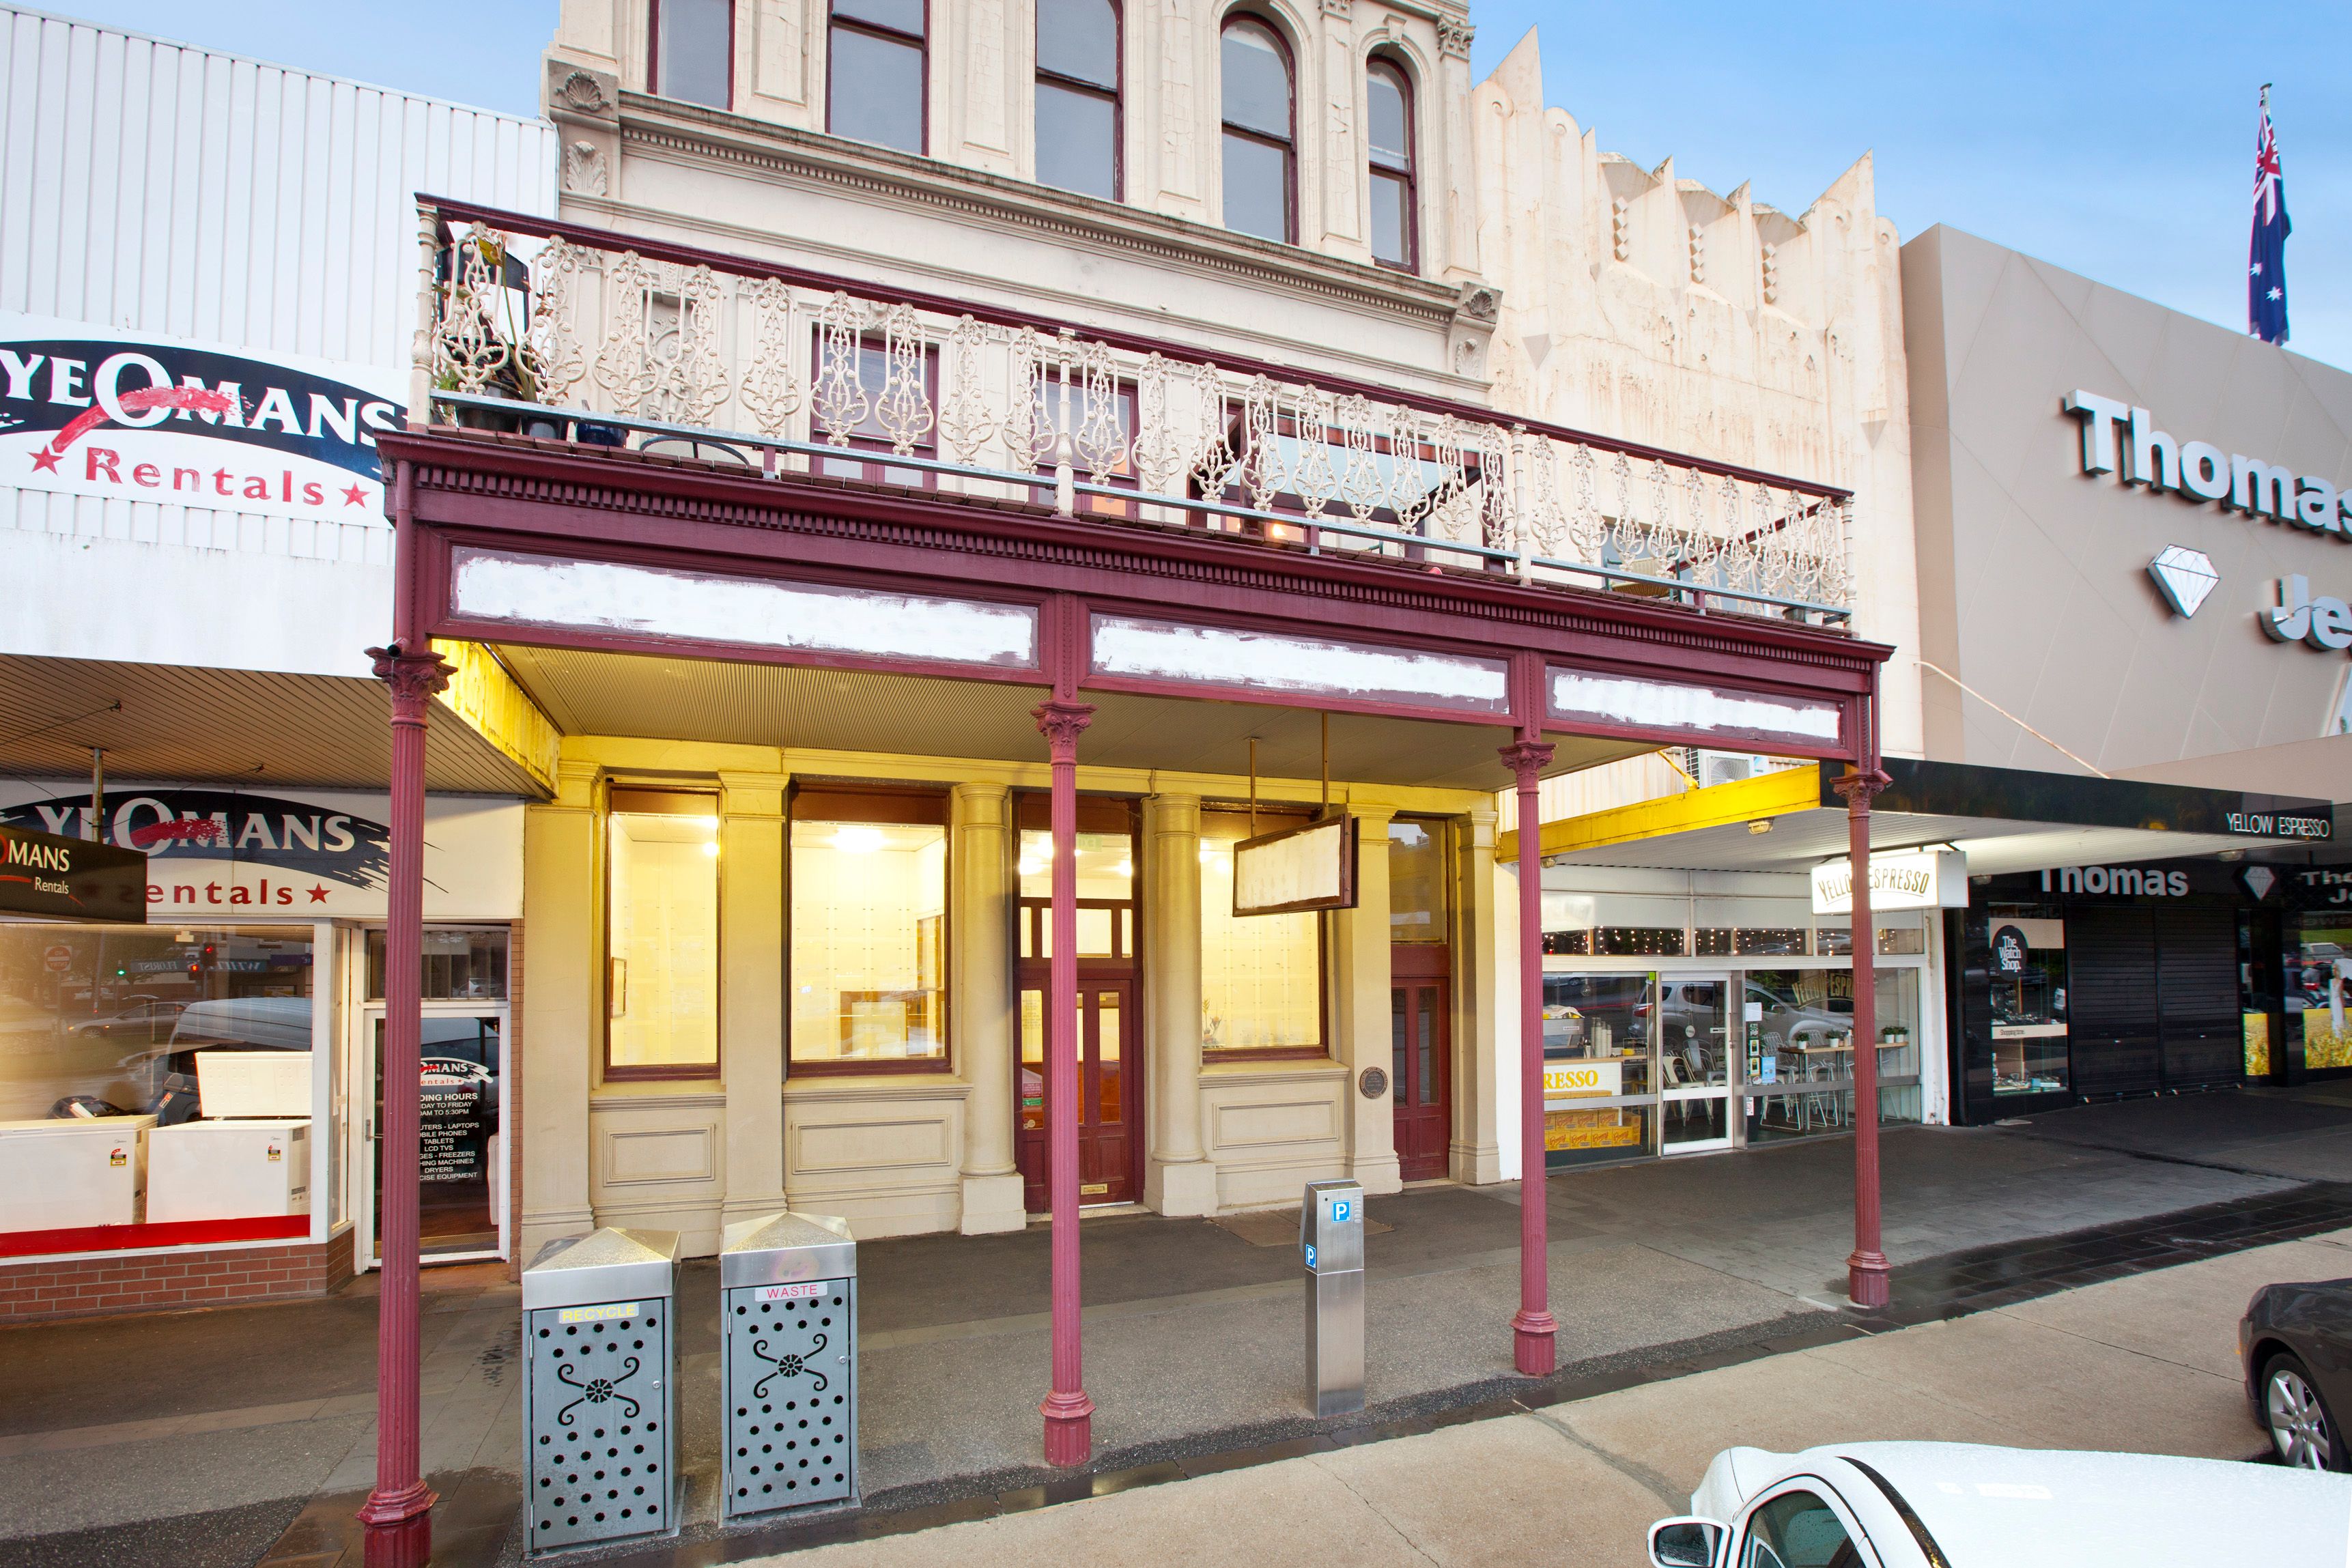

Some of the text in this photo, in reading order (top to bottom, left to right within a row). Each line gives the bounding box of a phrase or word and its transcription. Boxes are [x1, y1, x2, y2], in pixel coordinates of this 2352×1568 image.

[0, 349, 395, 448] YEOMANS
[86, 446, 325, 506] Rentals
[2269, 573, 2352, 649] Je
[2226, 813, 2329, 837] YELLOW ESPRESSO
[35, 876, 70, 894] Rentals
[146, 879, 293, 905] entals
[1818, 874, 1852, 902] YELLO
[2002, 936, 2017, 948] The
[1998, 947, 2022, 958] Watch
[2002, 958, 2022, 972] Shop.
[1791, 976, 1827, 1006] YELLOW
[1544, 1070, 1598, 1089] RESSO
[421, 1092, 478, 1102] DING HOURS
[1335, 1203, 1347, 1221] P
[1307, 1247, 1314, 1263] P
[767, 1284, 818, 1299] WASTE
[563, 1304, 636, 1322] RECYCLE
